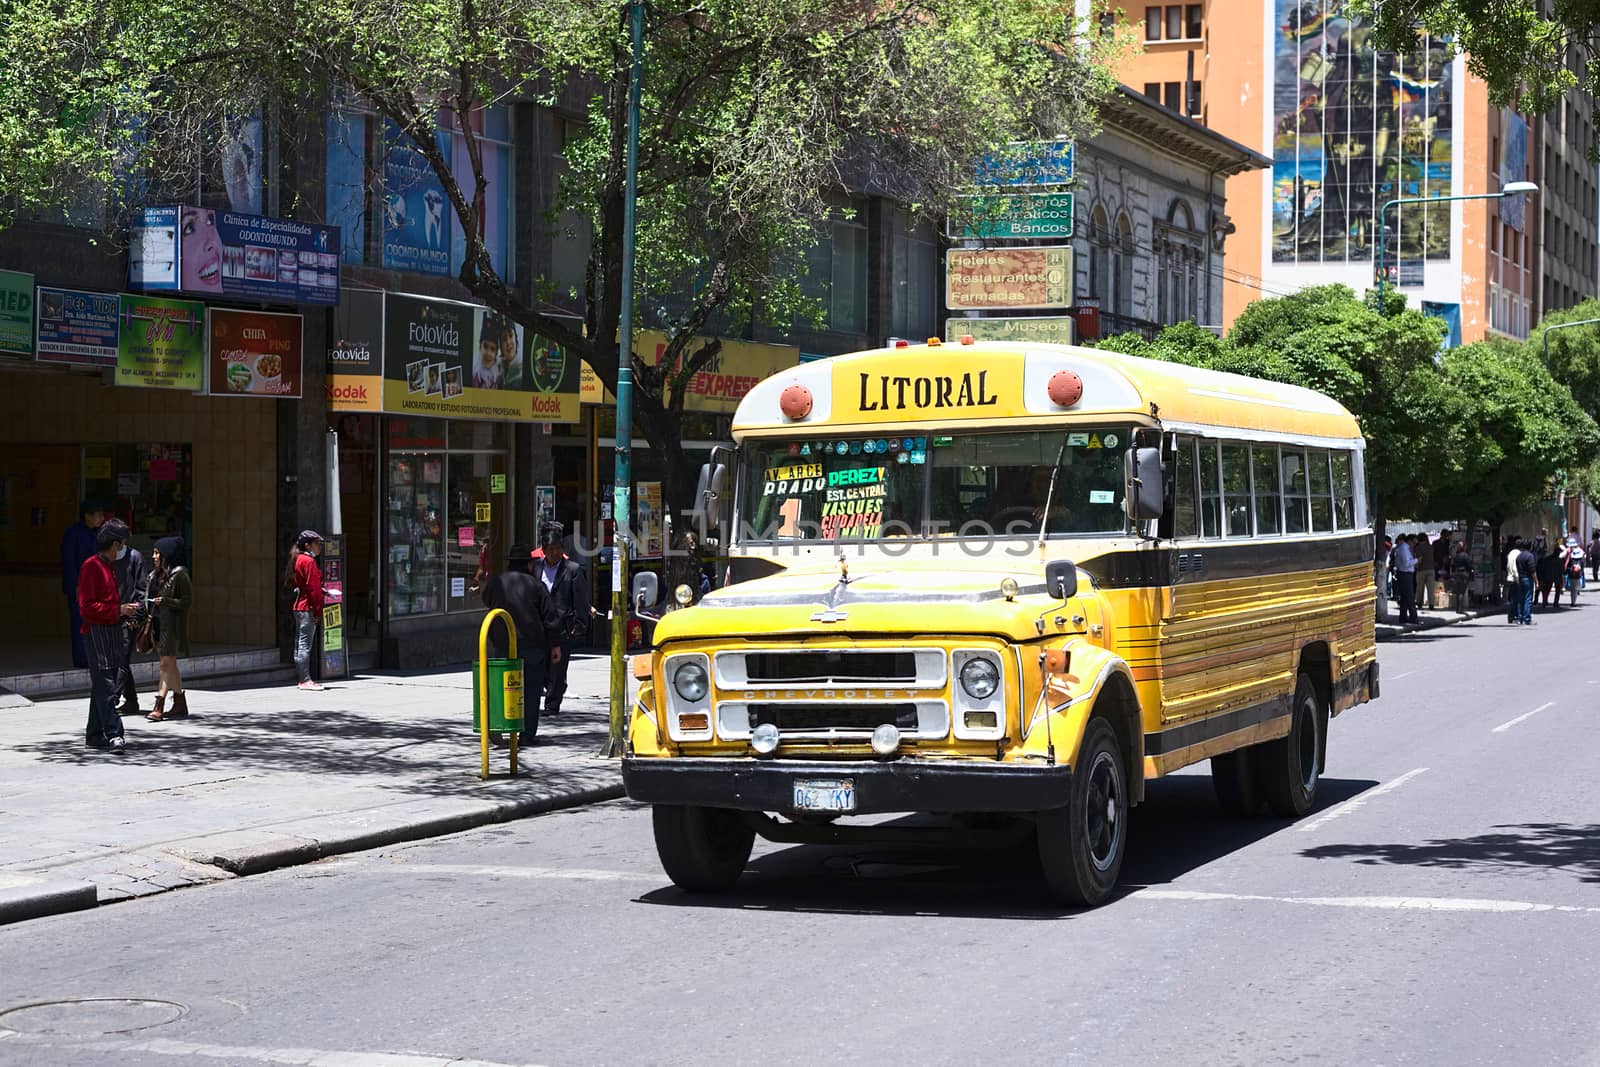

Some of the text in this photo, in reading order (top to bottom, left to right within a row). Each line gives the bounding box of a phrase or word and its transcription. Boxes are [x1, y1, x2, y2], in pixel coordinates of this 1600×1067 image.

[251, 218, 260, 228] de
[261, 219, 311, 235] Especialidades
[1011, 223, 1067, 233] Bancos
[240, 230, 297, 246] ODONTOMUNDO
[952, 255, 1005, 266] Hoteles
[951, 272, 1047, 284] Restaurantes
[951, 291, 1025, 302] Farmacias
[242, 328, 266, 340] CHIFA
[1004, 320, 1067, 332] Museos
[410, 322, 459, 347] FotoVida
[328, 347, 370, 361] FotoVida
[683, 350, 720, 373] Kdak
[326, 384, 368, 399] Kodak
[859, 369, 998, 412] LITORAL
[402, 400, 436, 411] LABORATORIO
[441, 403, 461, 412] ESTUDIO
[532, 396, 561, 413] Kodak
[765, 464, 822, 481] AV. ARCE
[829, 467, 878, 487] PEREZ
[763, 478, 825, 496] PRADO
[827, 484, 887, 501] EST. CENTRAL
[822, 498, 883, 517] VASQUES
[778, 498, 802, 540] 1
[821, 511, 883, 530] CIUDADELA
[325, 612, 334, 627] 10
[743, 690, 919, 699] CHEVROLET
